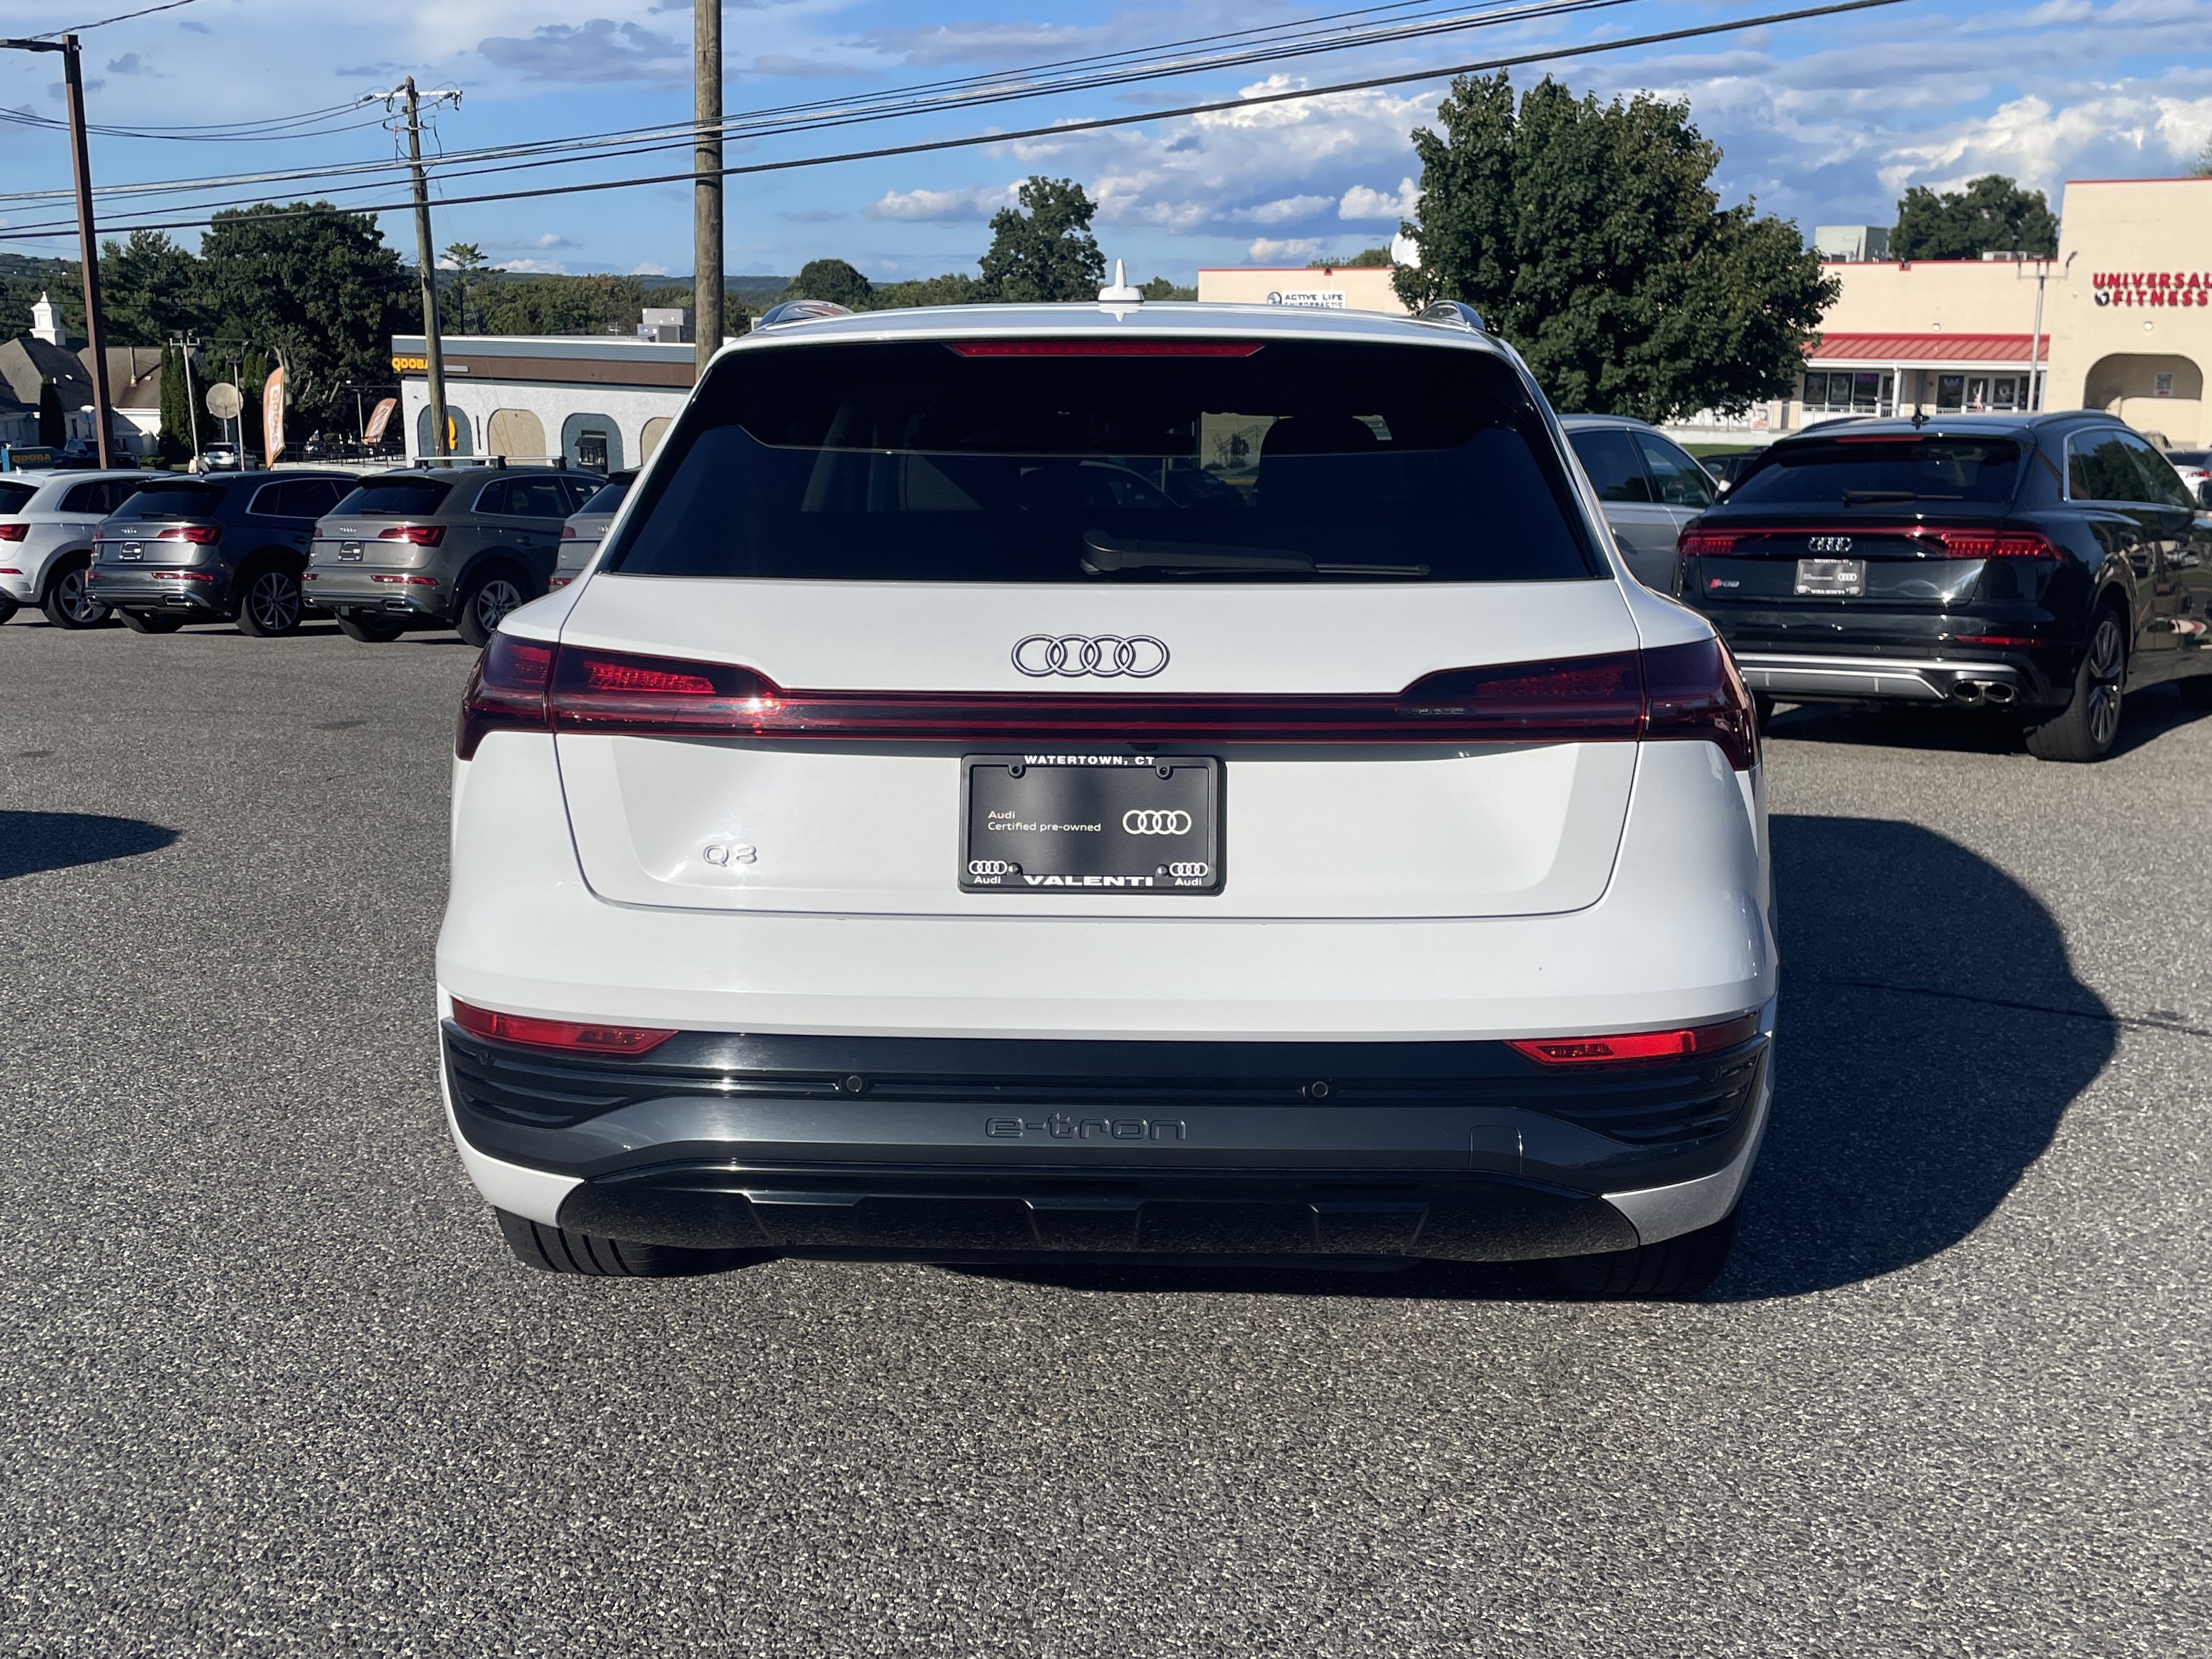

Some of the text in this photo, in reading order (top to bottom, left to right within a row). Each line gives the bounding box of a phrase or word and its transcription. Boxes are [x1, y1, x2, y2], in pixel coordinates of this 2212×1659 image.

[2093, 272, 2212, 289] UNIVERSAL
[2113, 289, 2208, 307] FITNESS
[1024, 755, 1155, 766] WATERTOWN, CT
[988, 811, 1016, 819] Audi
[988, 821, 1101, 833] Certified pre-owned
[703, 844, 758, 868] Q8
[973, 875, 1001, 884] Audi
[1023, 875, 1154, 886] VALENTI
[1174, 877, 1202, 886] Audi
[985, 1112, 1186, 1140] e-tron
